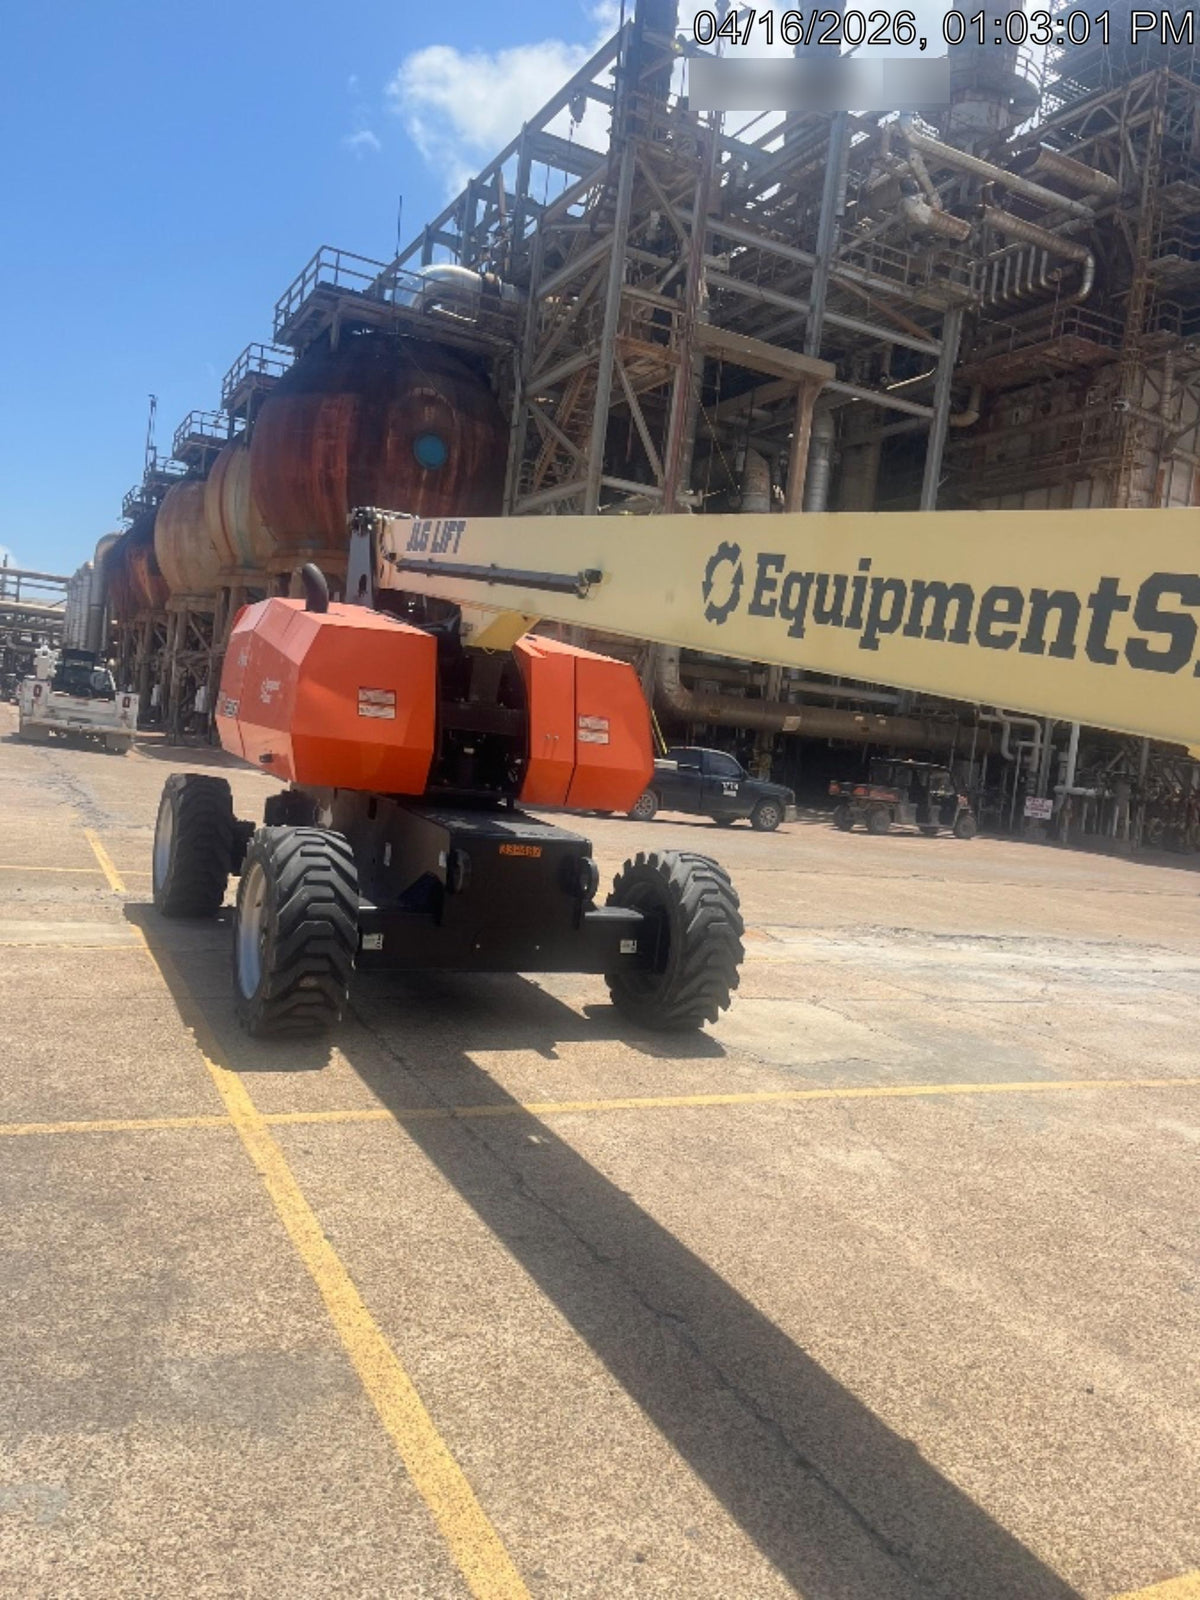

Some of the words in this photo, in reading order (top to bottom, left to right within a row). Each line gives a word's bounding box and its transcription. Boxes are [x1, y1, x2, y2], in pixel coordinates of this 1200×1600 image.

[406, 521, 432, 552] JLG
[430, 520, 467, 554] LIFT
[748, 552, 1200, 678] EquipmentS
